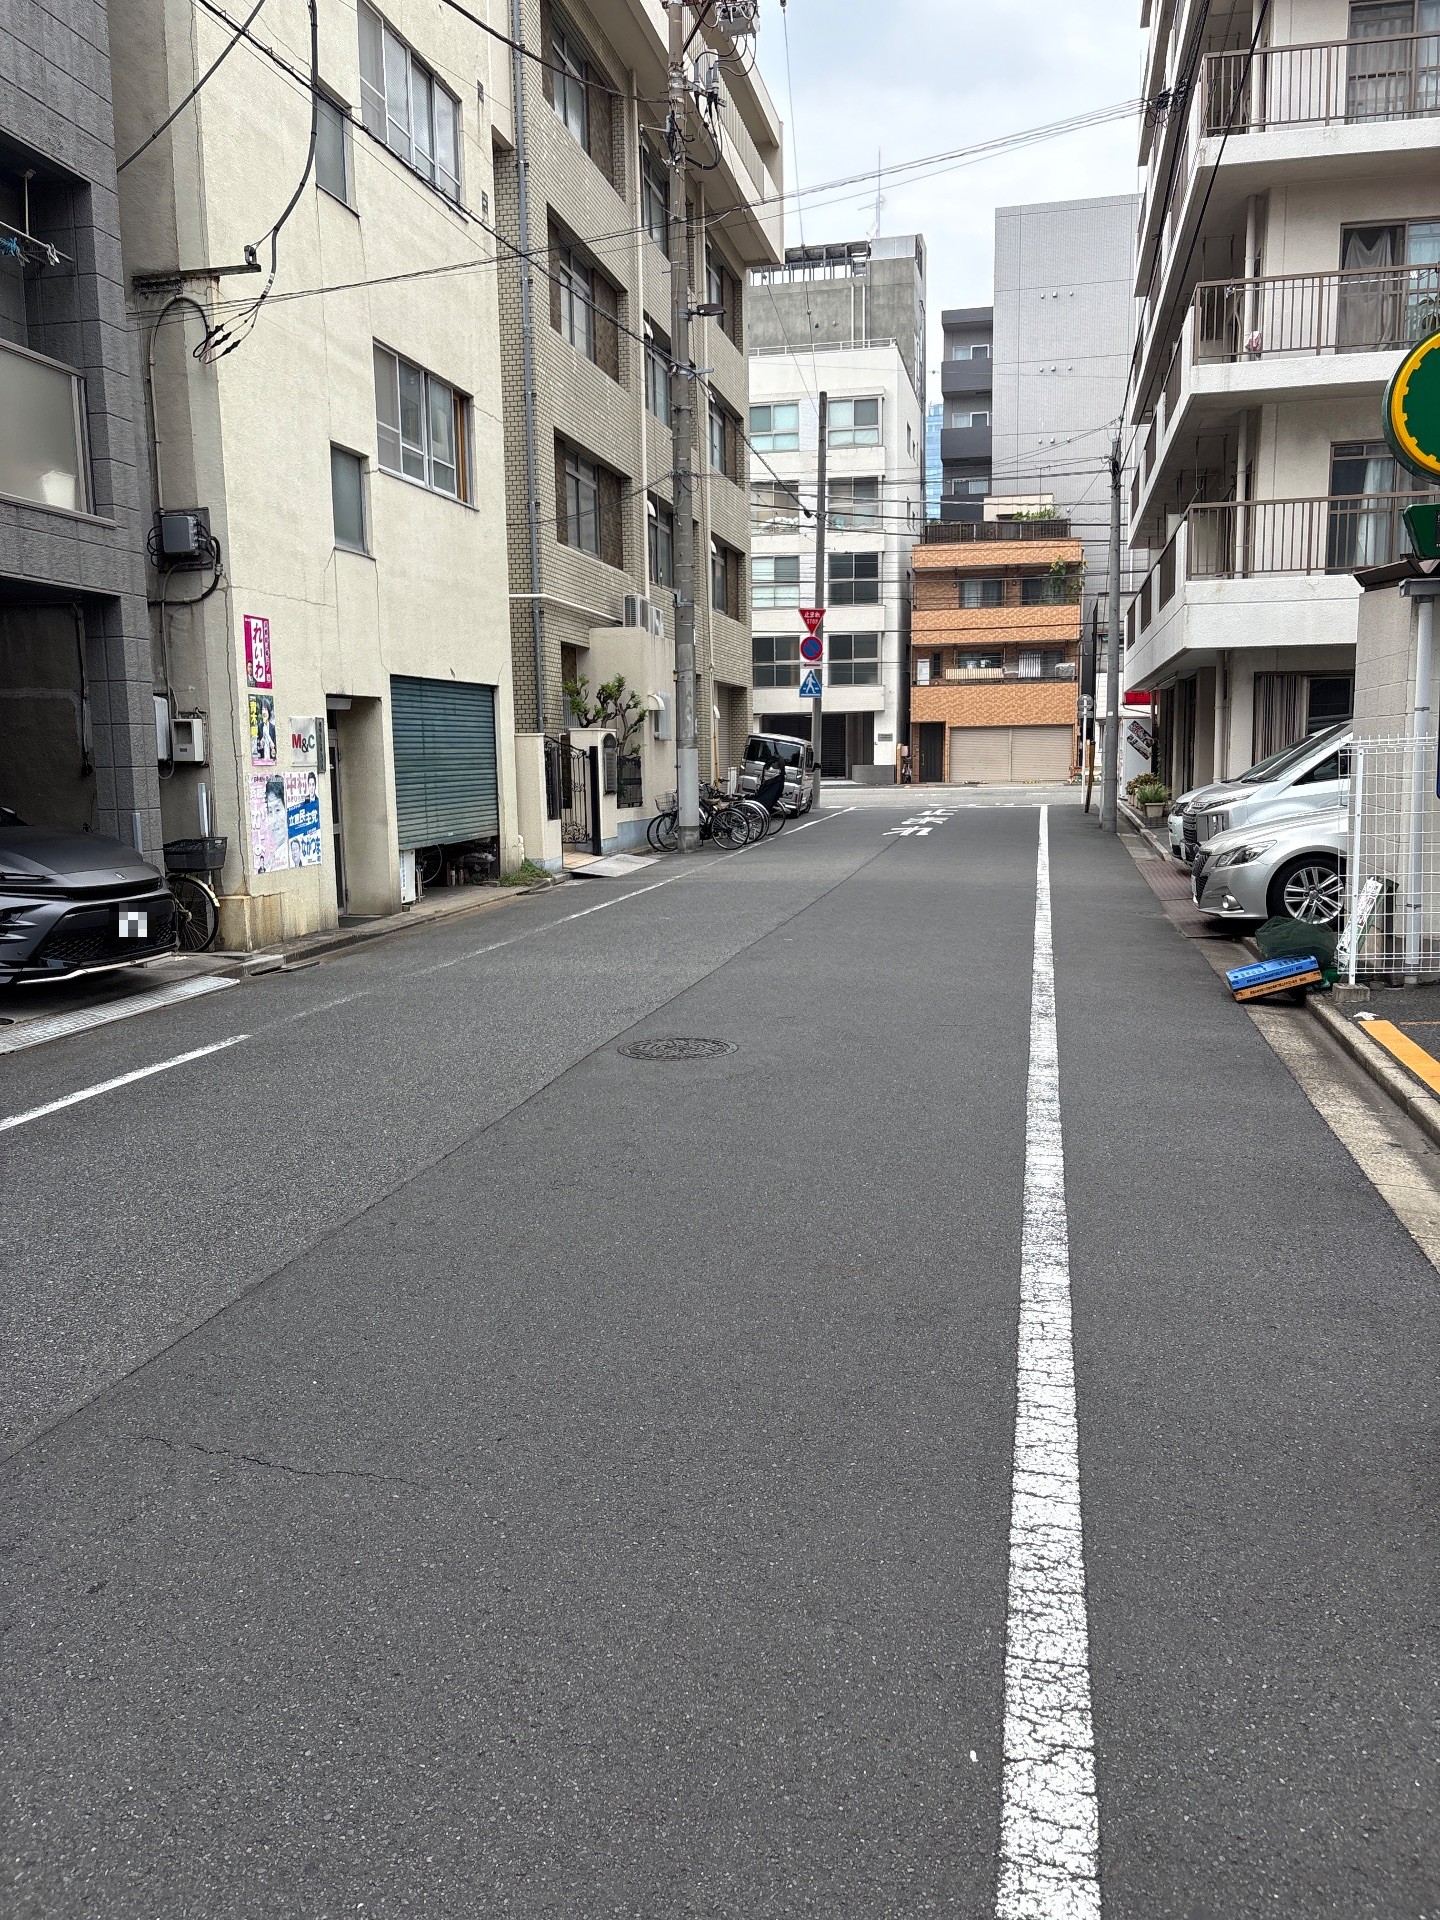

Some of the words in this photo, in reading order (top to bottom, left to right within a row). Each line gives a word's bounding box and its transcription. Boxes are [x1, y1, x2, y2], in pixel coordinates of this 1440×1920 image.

[253, 622, 264, 679] れいわ
[292, 734, 315, 754] M&C
[286, 774, 307, 795] 中村
